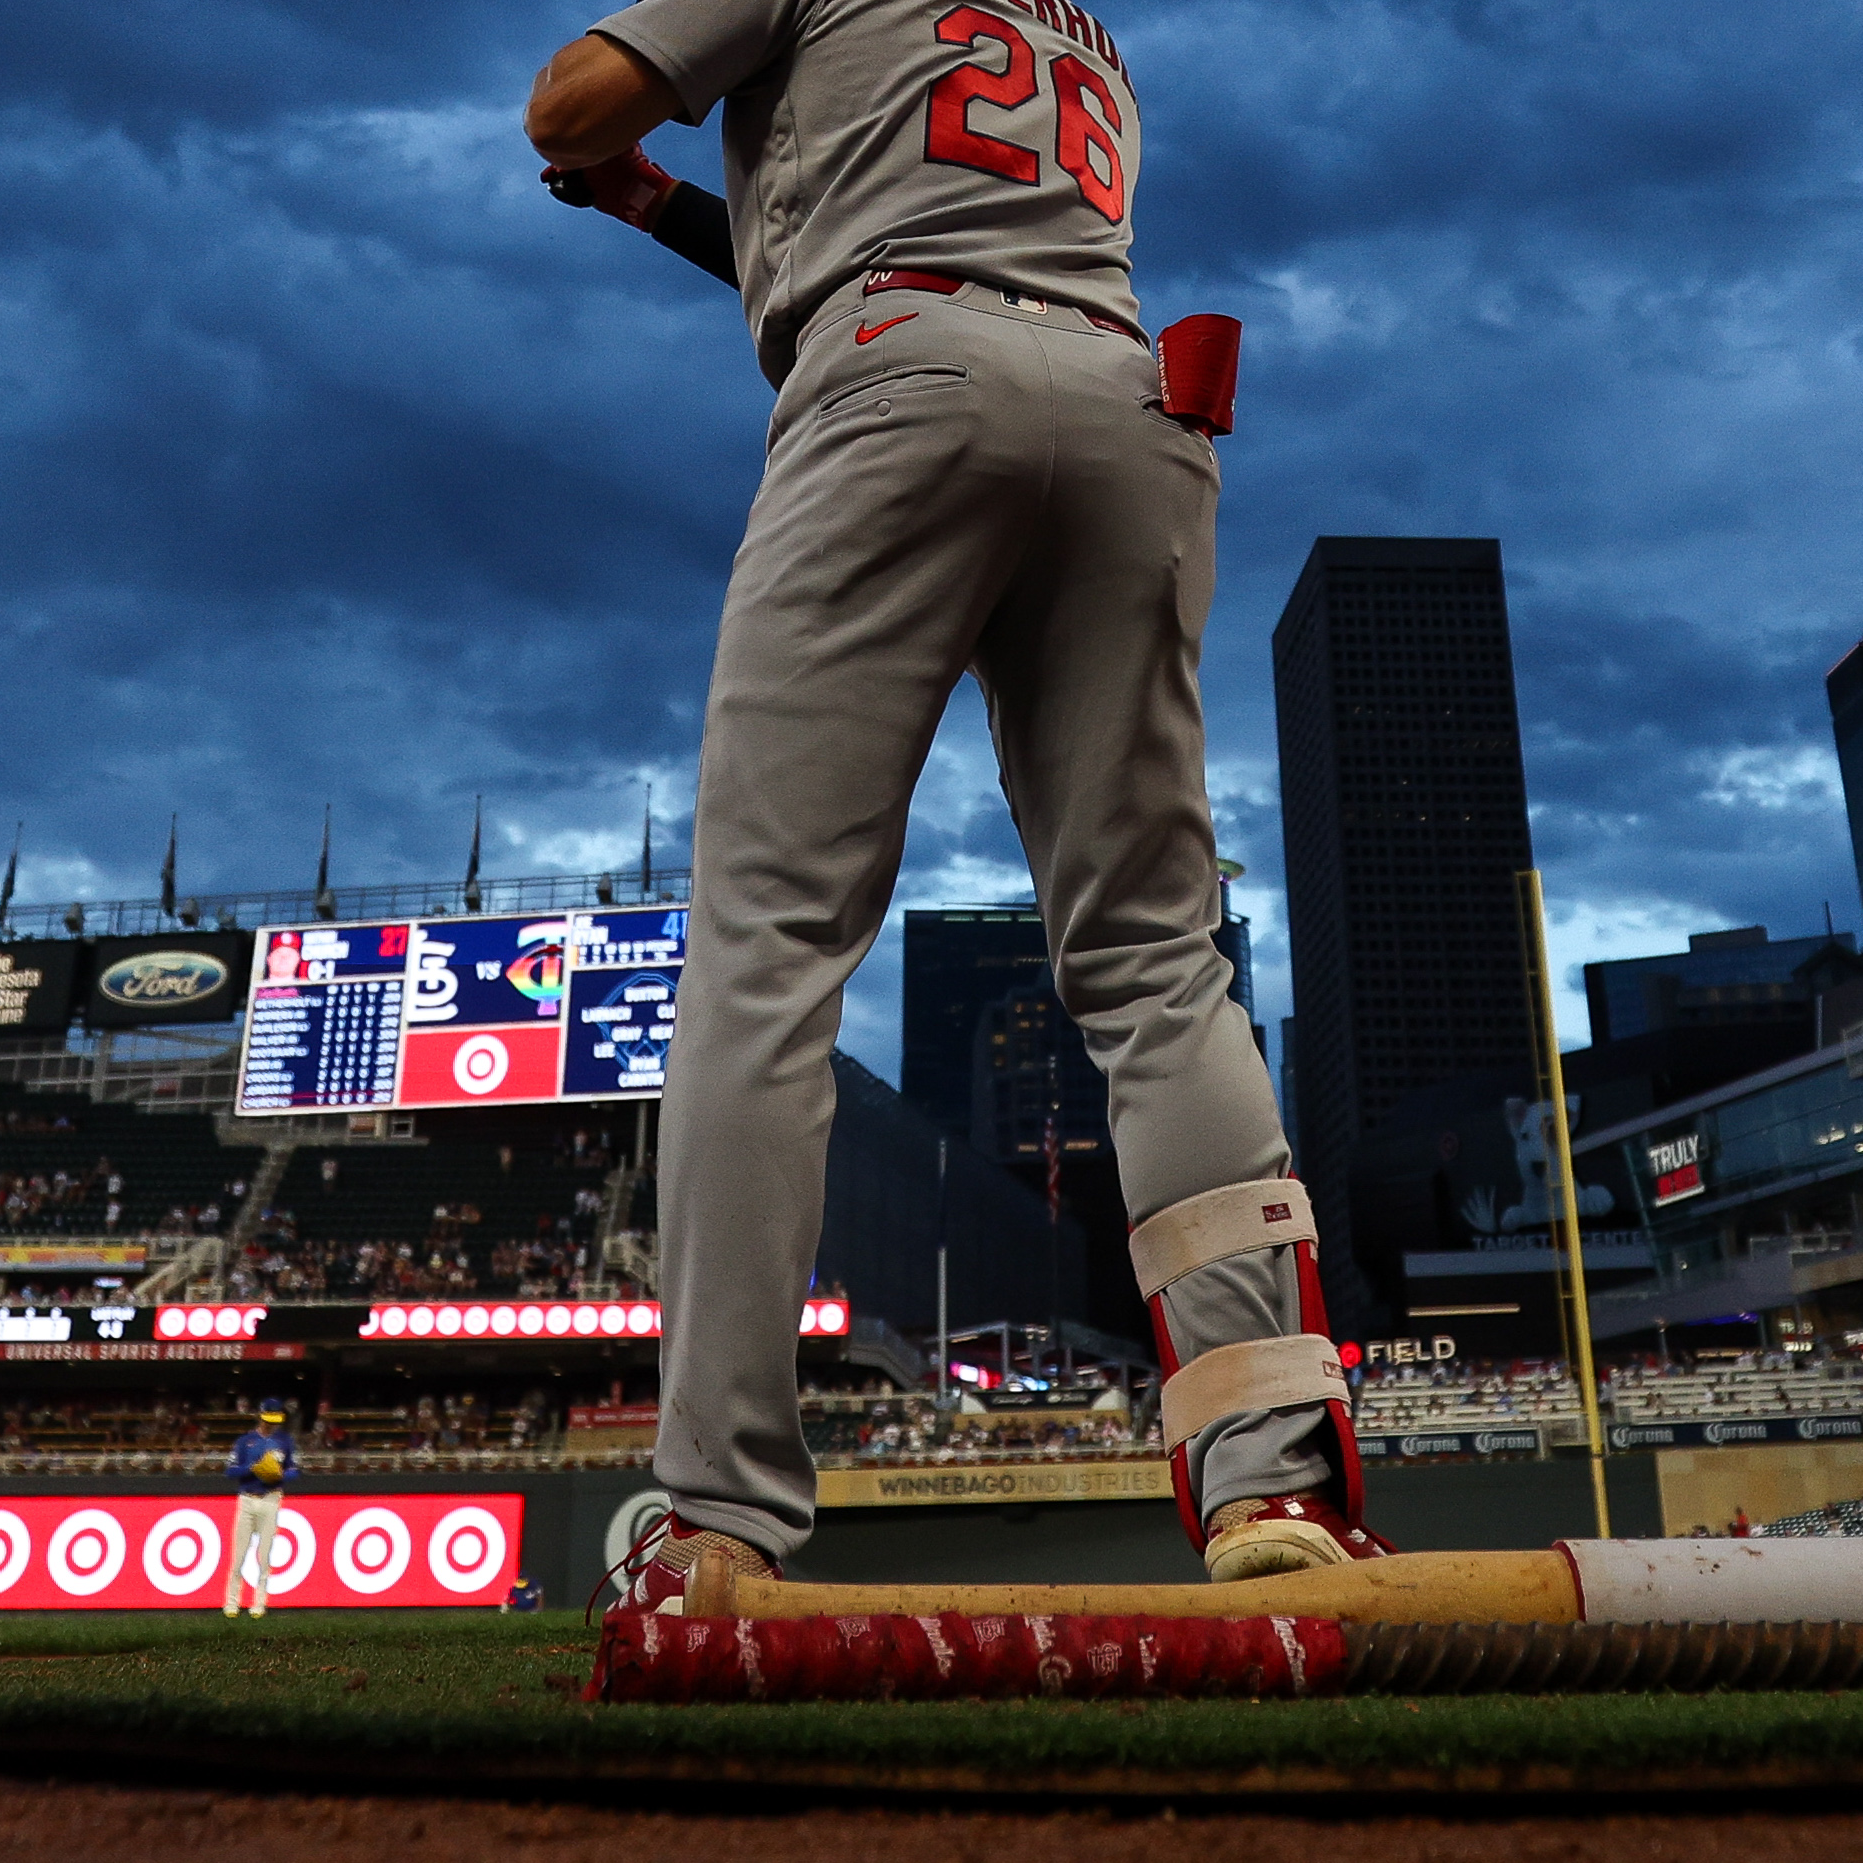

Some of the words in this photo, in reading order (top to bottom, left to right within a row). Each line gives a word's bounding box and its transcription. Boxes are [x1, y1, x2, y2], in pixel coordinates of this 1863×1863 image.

[924, 4, 1123, 226] 26
[121, 963, 201, 998] Ford
[1649, 1135, 1700, 1176] TRULY
[4, 1342, 92, 1360] UNIVERSAL
[98, 1342, 159, 1360] SPORTS
[164, 1342, 244, 1360] AUCTIONS
[1366, 1335, 1456, 1365] FIELD
[1610, 1425, 1675, 1449] Corona
[1701, 1420, 1768, 1443] Corona
[1796, 1413, 1863, 1438] Corona
[1397, 1435, 1462, 1457] Corona
[1473, 1432, 1537, 1454] Corona
[877, 1474, 1016, 1497] WINNEBAGO
[1016, 1470, 1159, 1493] INDUSTRIES
